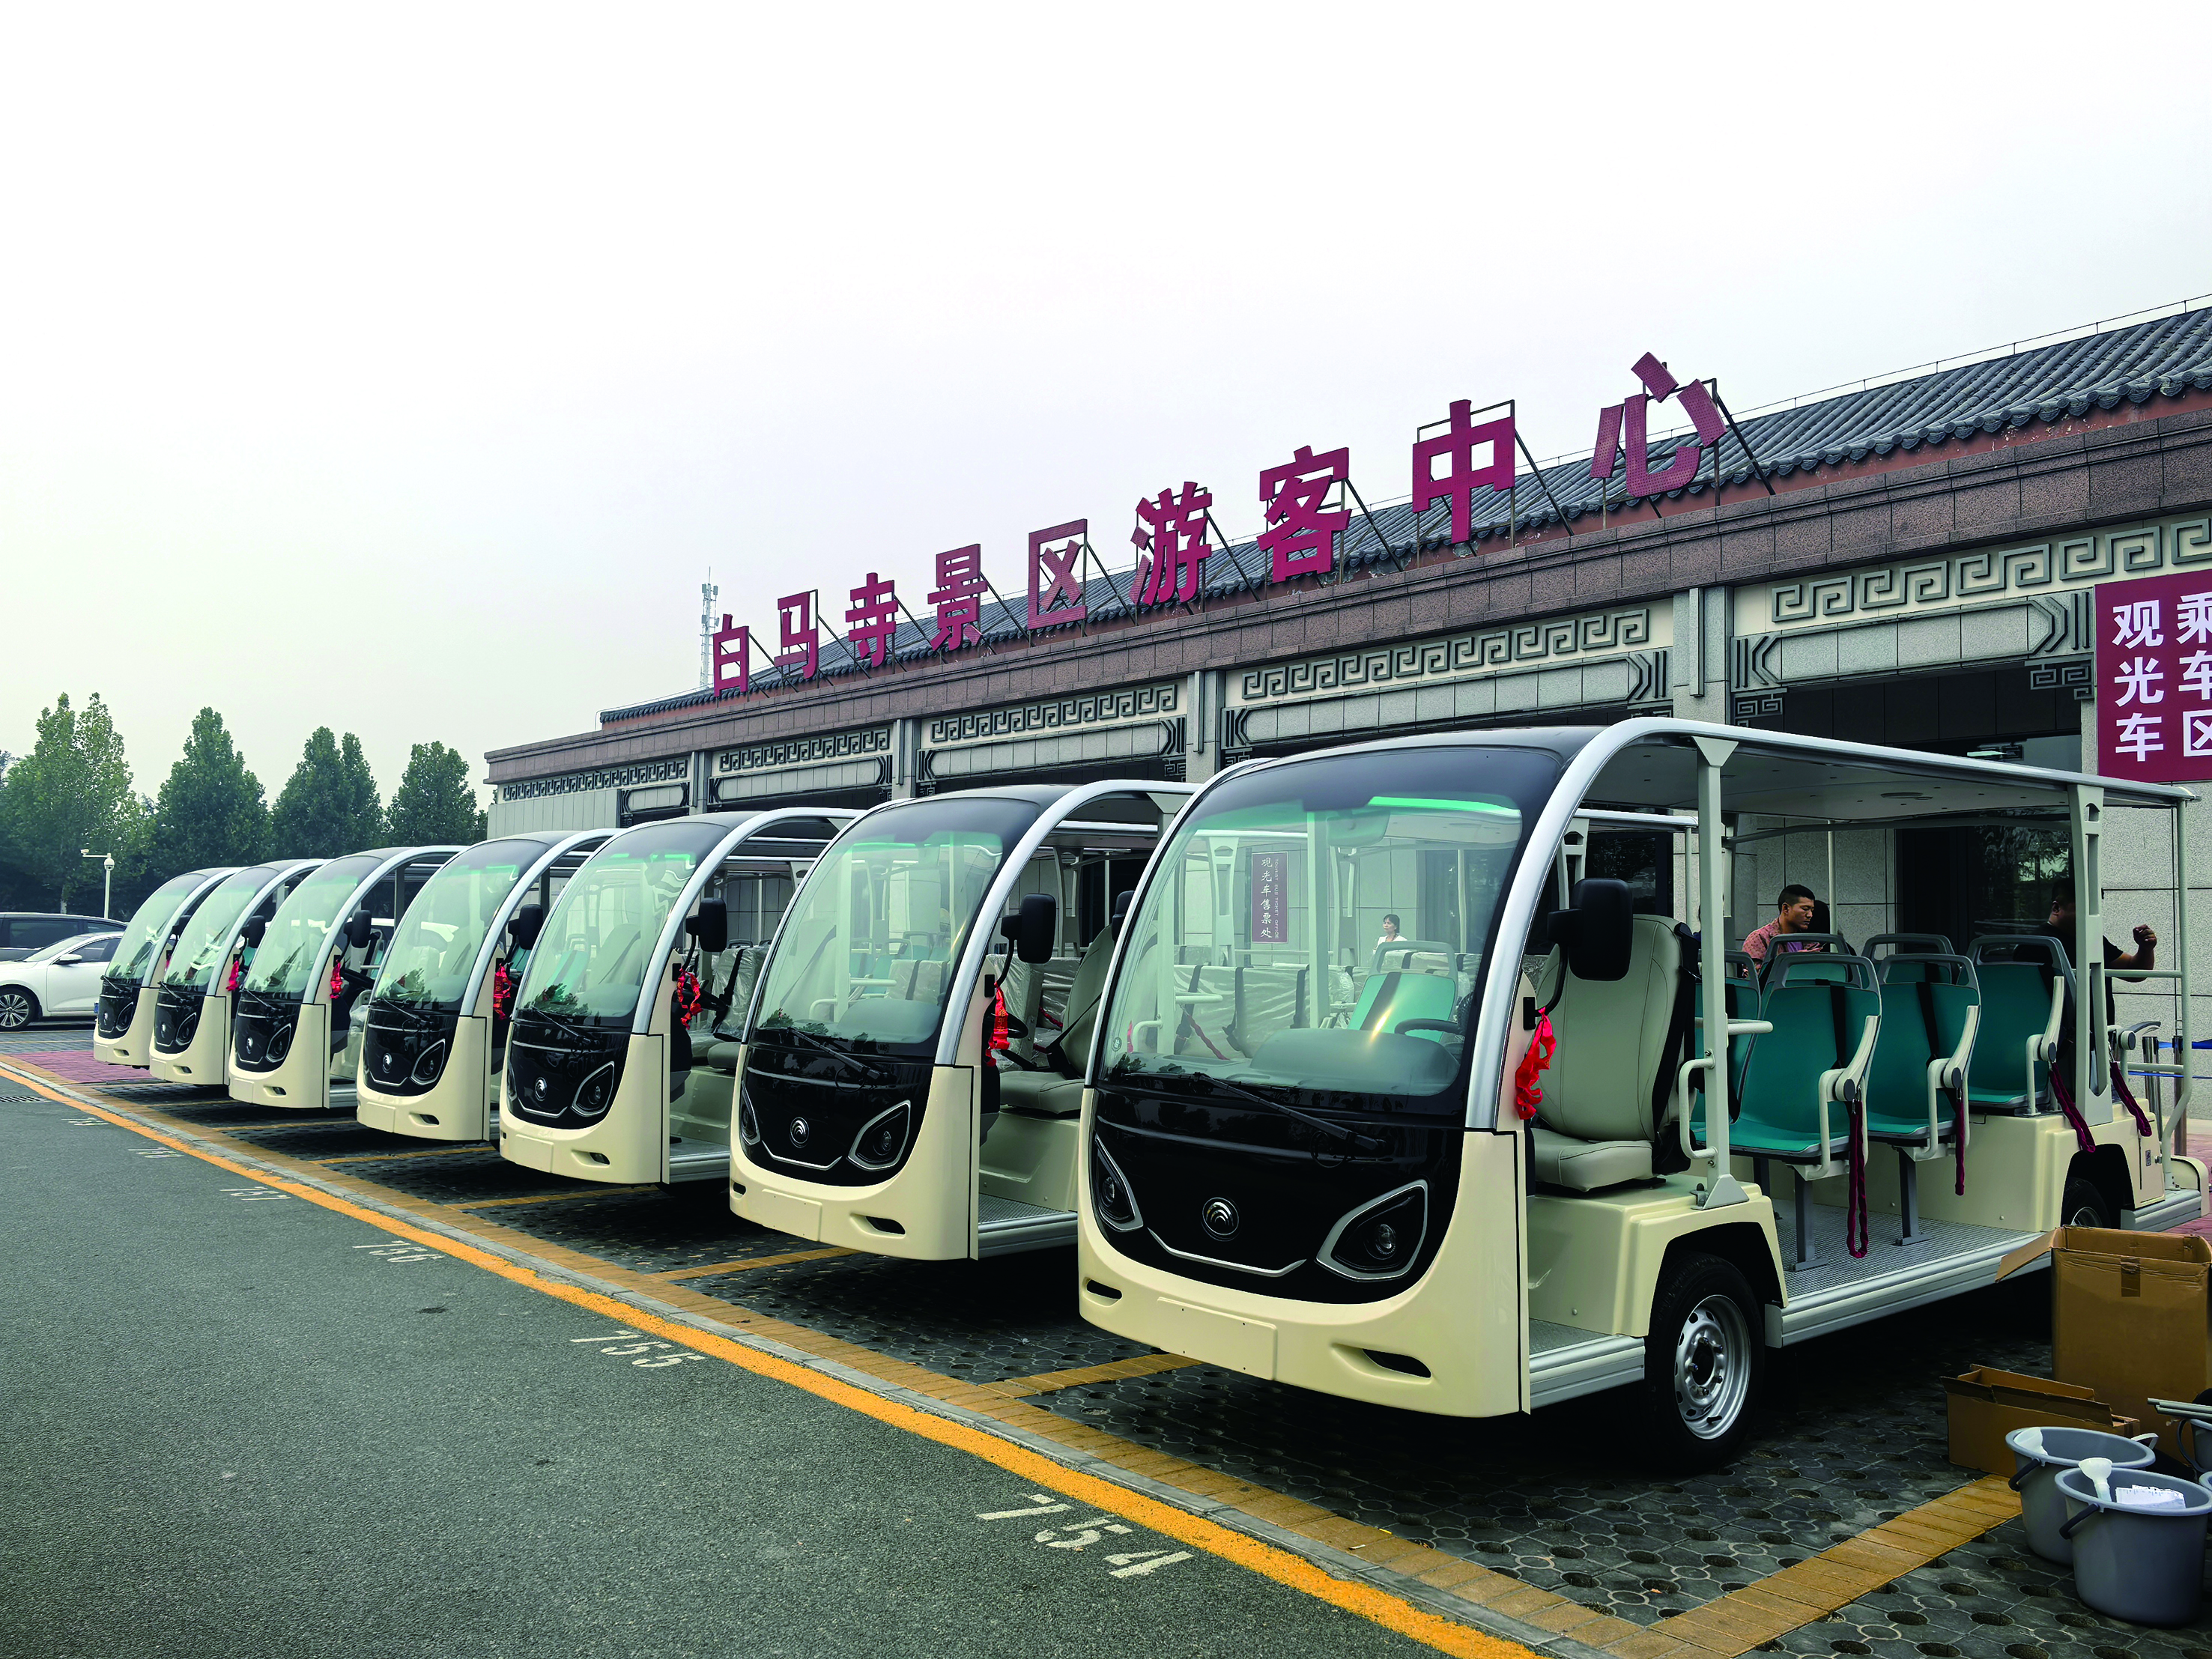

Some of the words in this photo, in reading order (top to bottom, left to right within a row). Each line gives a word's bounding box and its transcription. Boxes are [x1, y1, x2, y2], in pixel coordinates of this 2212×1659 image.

[712, 352, 1727, 697] 白马寺景区游客中心
[2112, 599, 2164, 762] 观光车
[1260, 858, 1273, 939] 观光车售票处
[570, 1330, 705, 1367] 755
[975, 1493, 1195, 1578] 754
